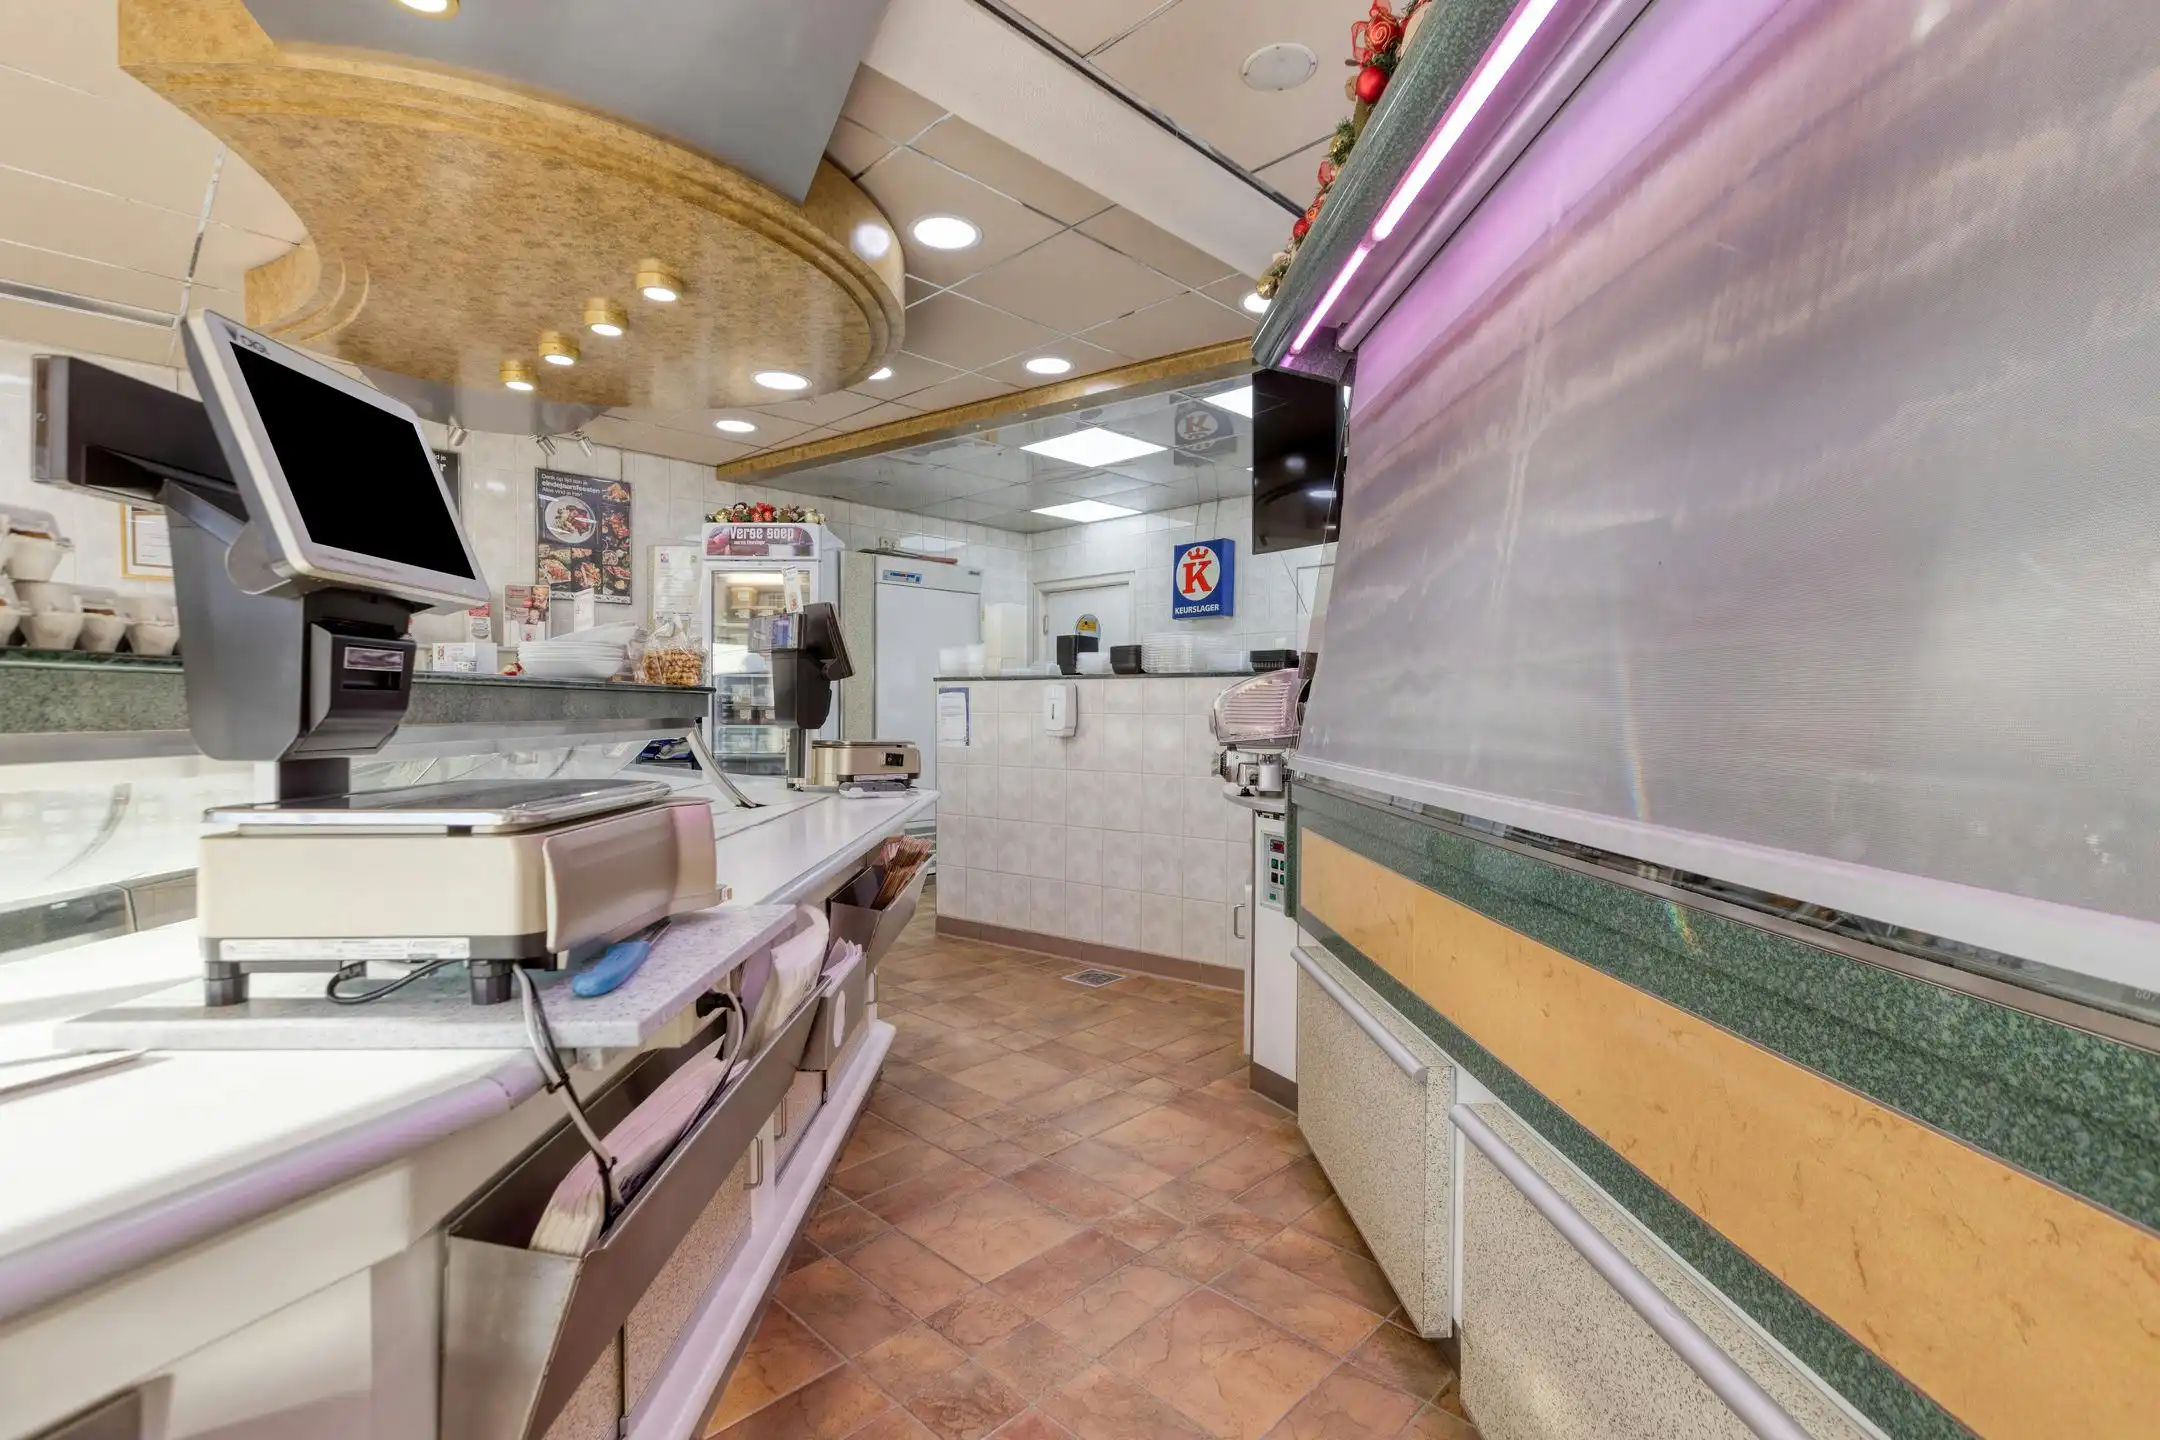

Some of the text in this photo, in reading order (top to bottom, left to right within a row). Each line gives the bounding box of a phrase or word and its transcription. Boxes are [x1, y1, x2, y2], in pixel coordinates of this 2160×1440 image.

[541, 480, 601, 494] eindejaarsfeesten
[730, 525, 794, 542] Verse soep
[1183, 560, 1212, 594] K
[1174, 604, 1220, 615] KEURSLAGER
